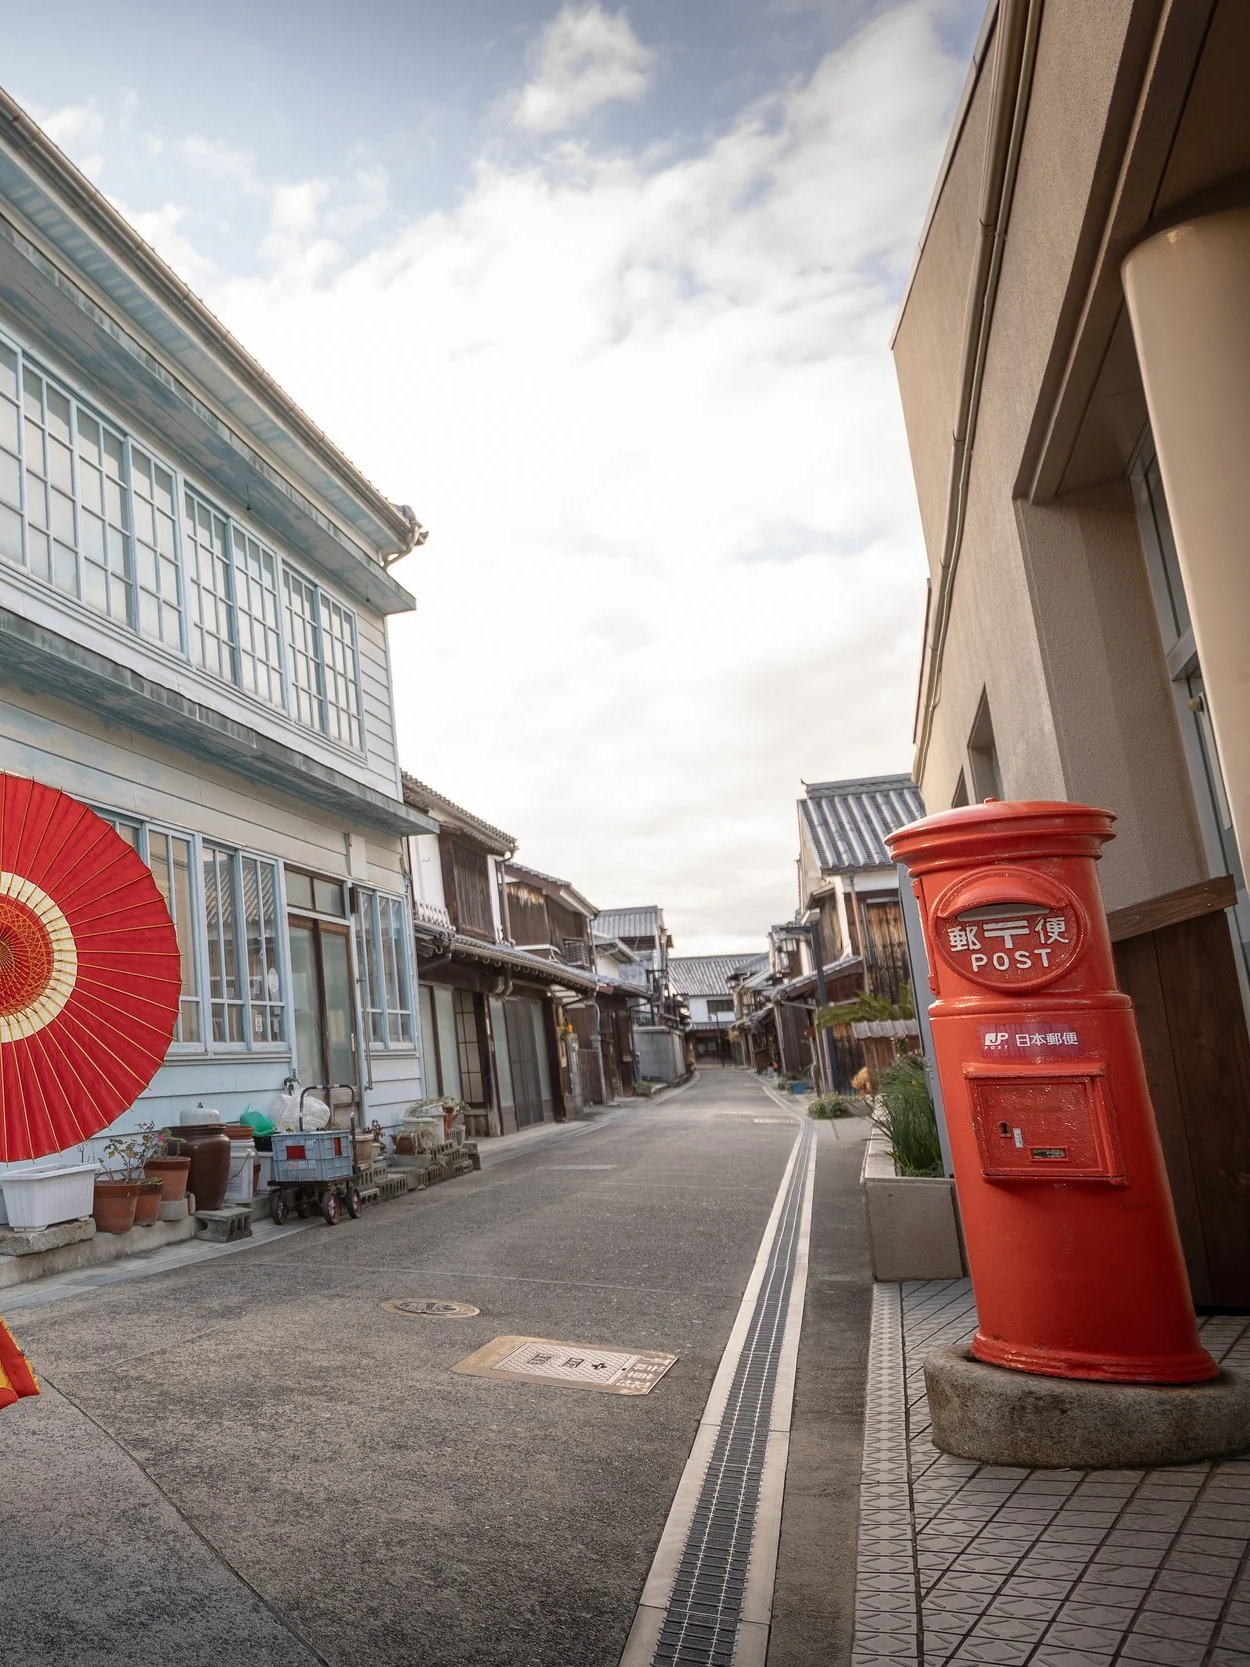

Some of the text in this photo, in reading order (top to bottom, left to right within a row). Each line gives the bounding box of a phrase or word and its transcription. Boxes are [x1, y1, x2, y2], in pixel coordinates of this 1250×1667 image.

[971, 948, 1052, 972] POST
[1016, 1032, 1078, 1047] 日本郵便
